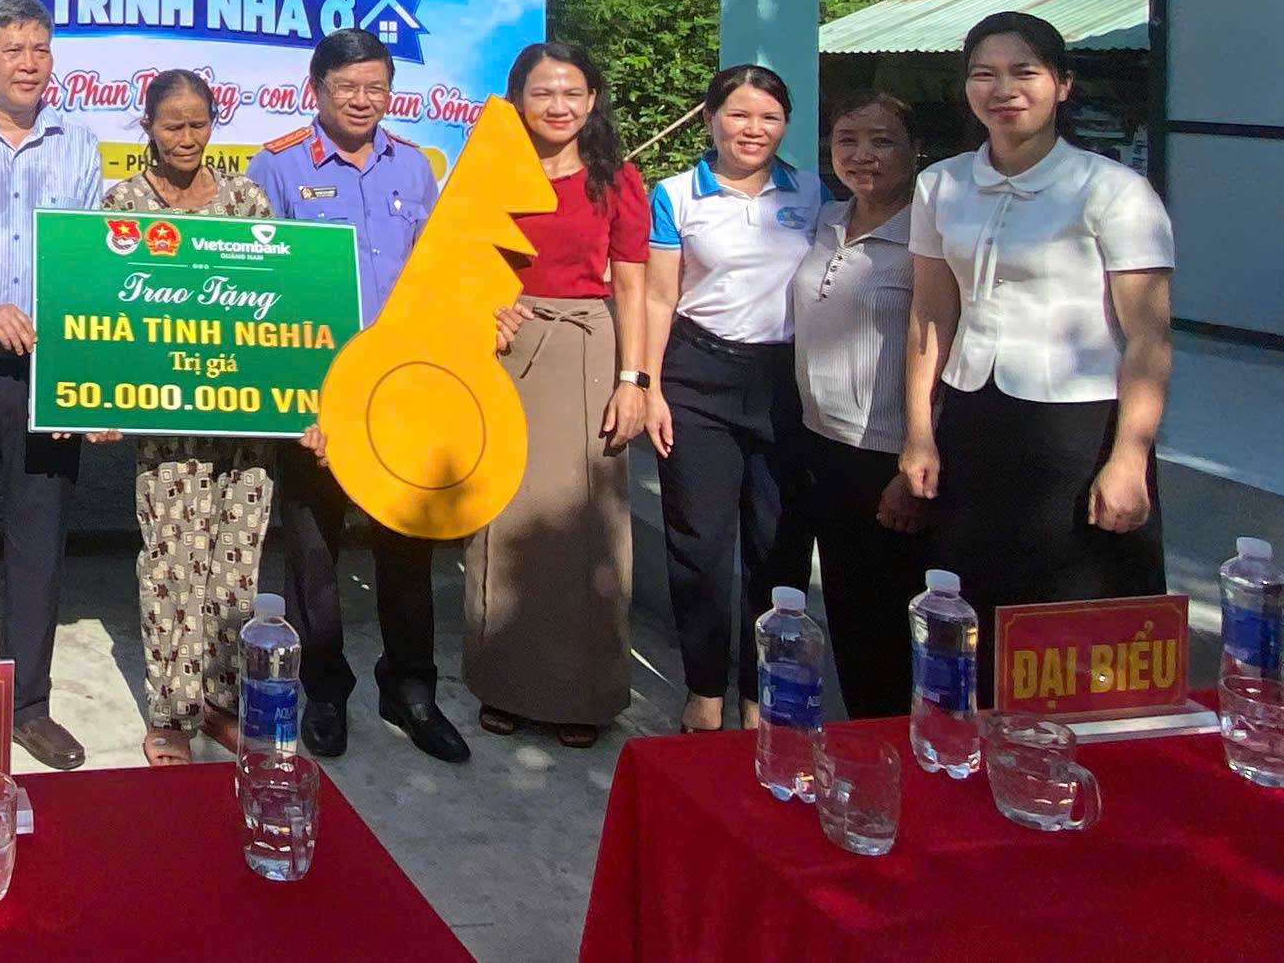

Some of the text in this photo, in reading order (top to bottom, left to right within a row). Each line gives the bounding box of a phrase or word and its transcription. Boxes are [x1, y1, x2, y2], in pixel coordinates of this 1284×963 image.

[66, 73, 129, 107] Phan
[259, 86, 295, 110] con
[191, 237, 291, 255] Vietcombank
[247, 253, 264, 262] NAM
[118, 272, 283, 321] Trao Tặng
[64, 312, 336, 349] NHÀ TÌNH NGHĨA
[169, 351, 239, 379] Trị giá
[55, 381, 320, 414] 50.000.000 VN
[1011, 620, 1178, 710] ĐẠI BIỂU
